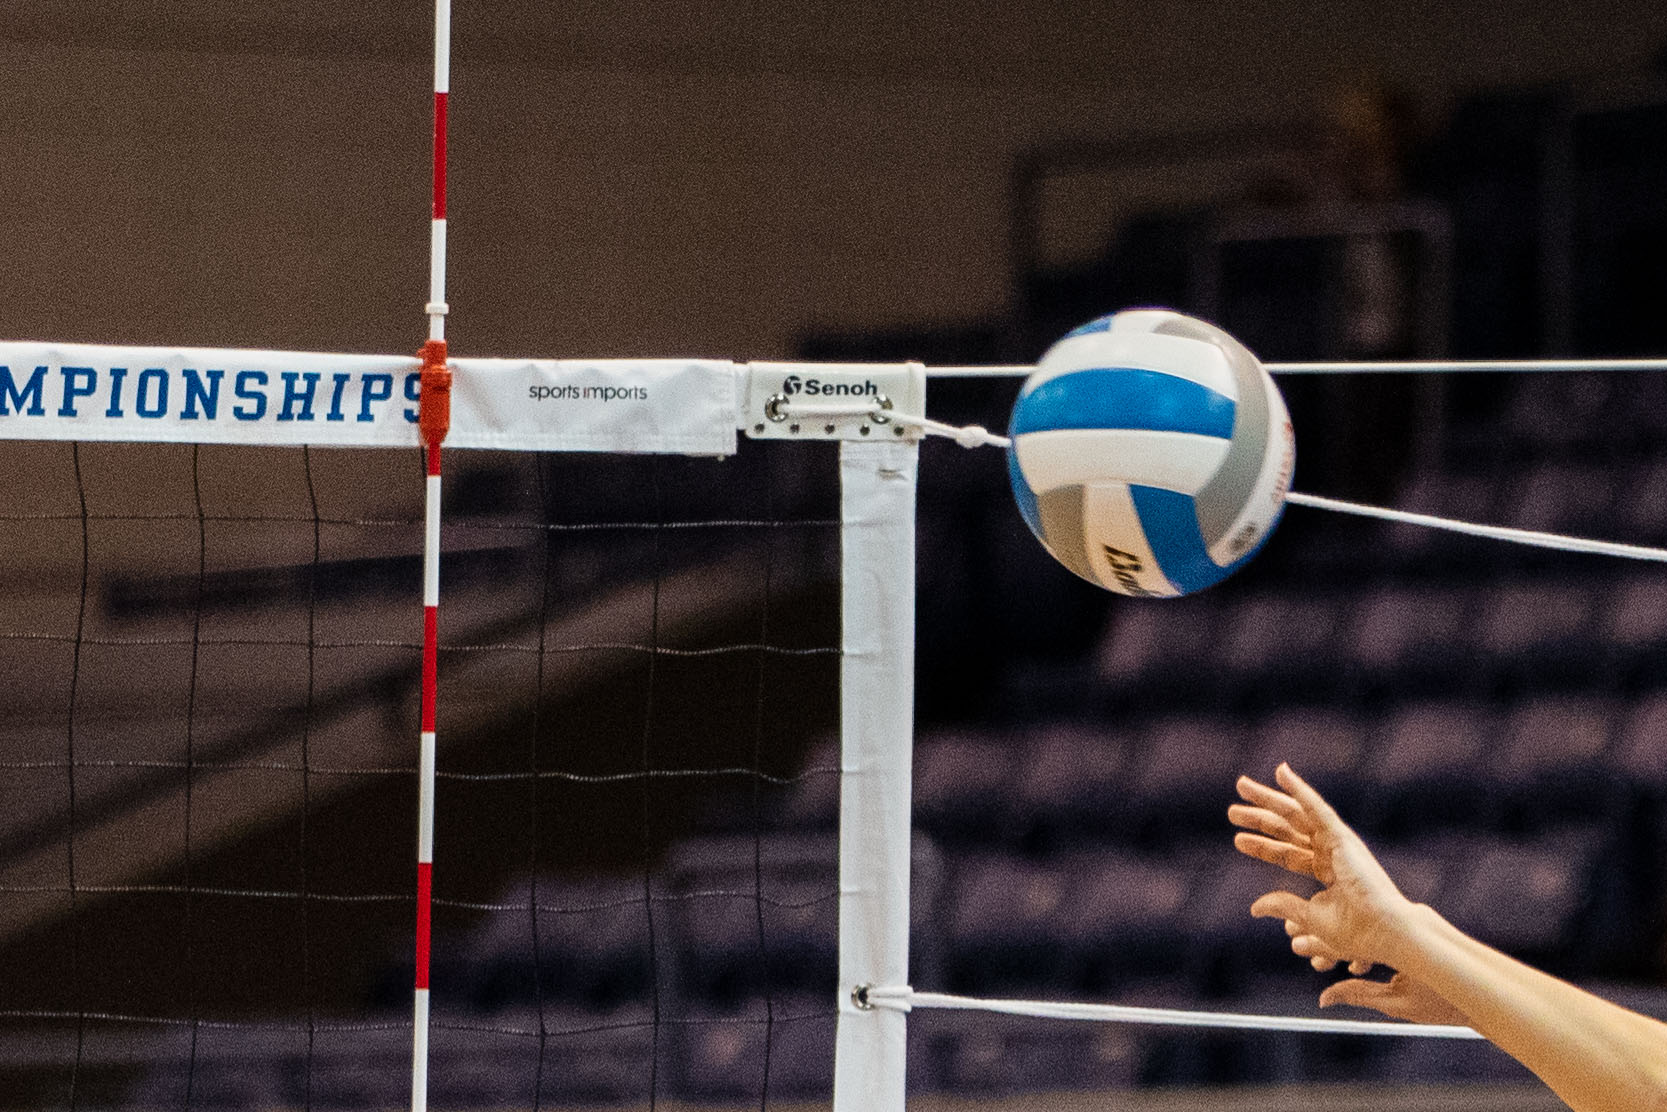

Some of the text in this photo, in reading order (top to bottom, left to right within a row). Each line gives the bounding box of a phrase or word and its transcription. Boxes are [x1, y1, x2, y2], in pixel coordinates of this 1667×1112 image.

[529, 384, 648, 402] sports imports
[805, 378, 878, 396] Senoh
